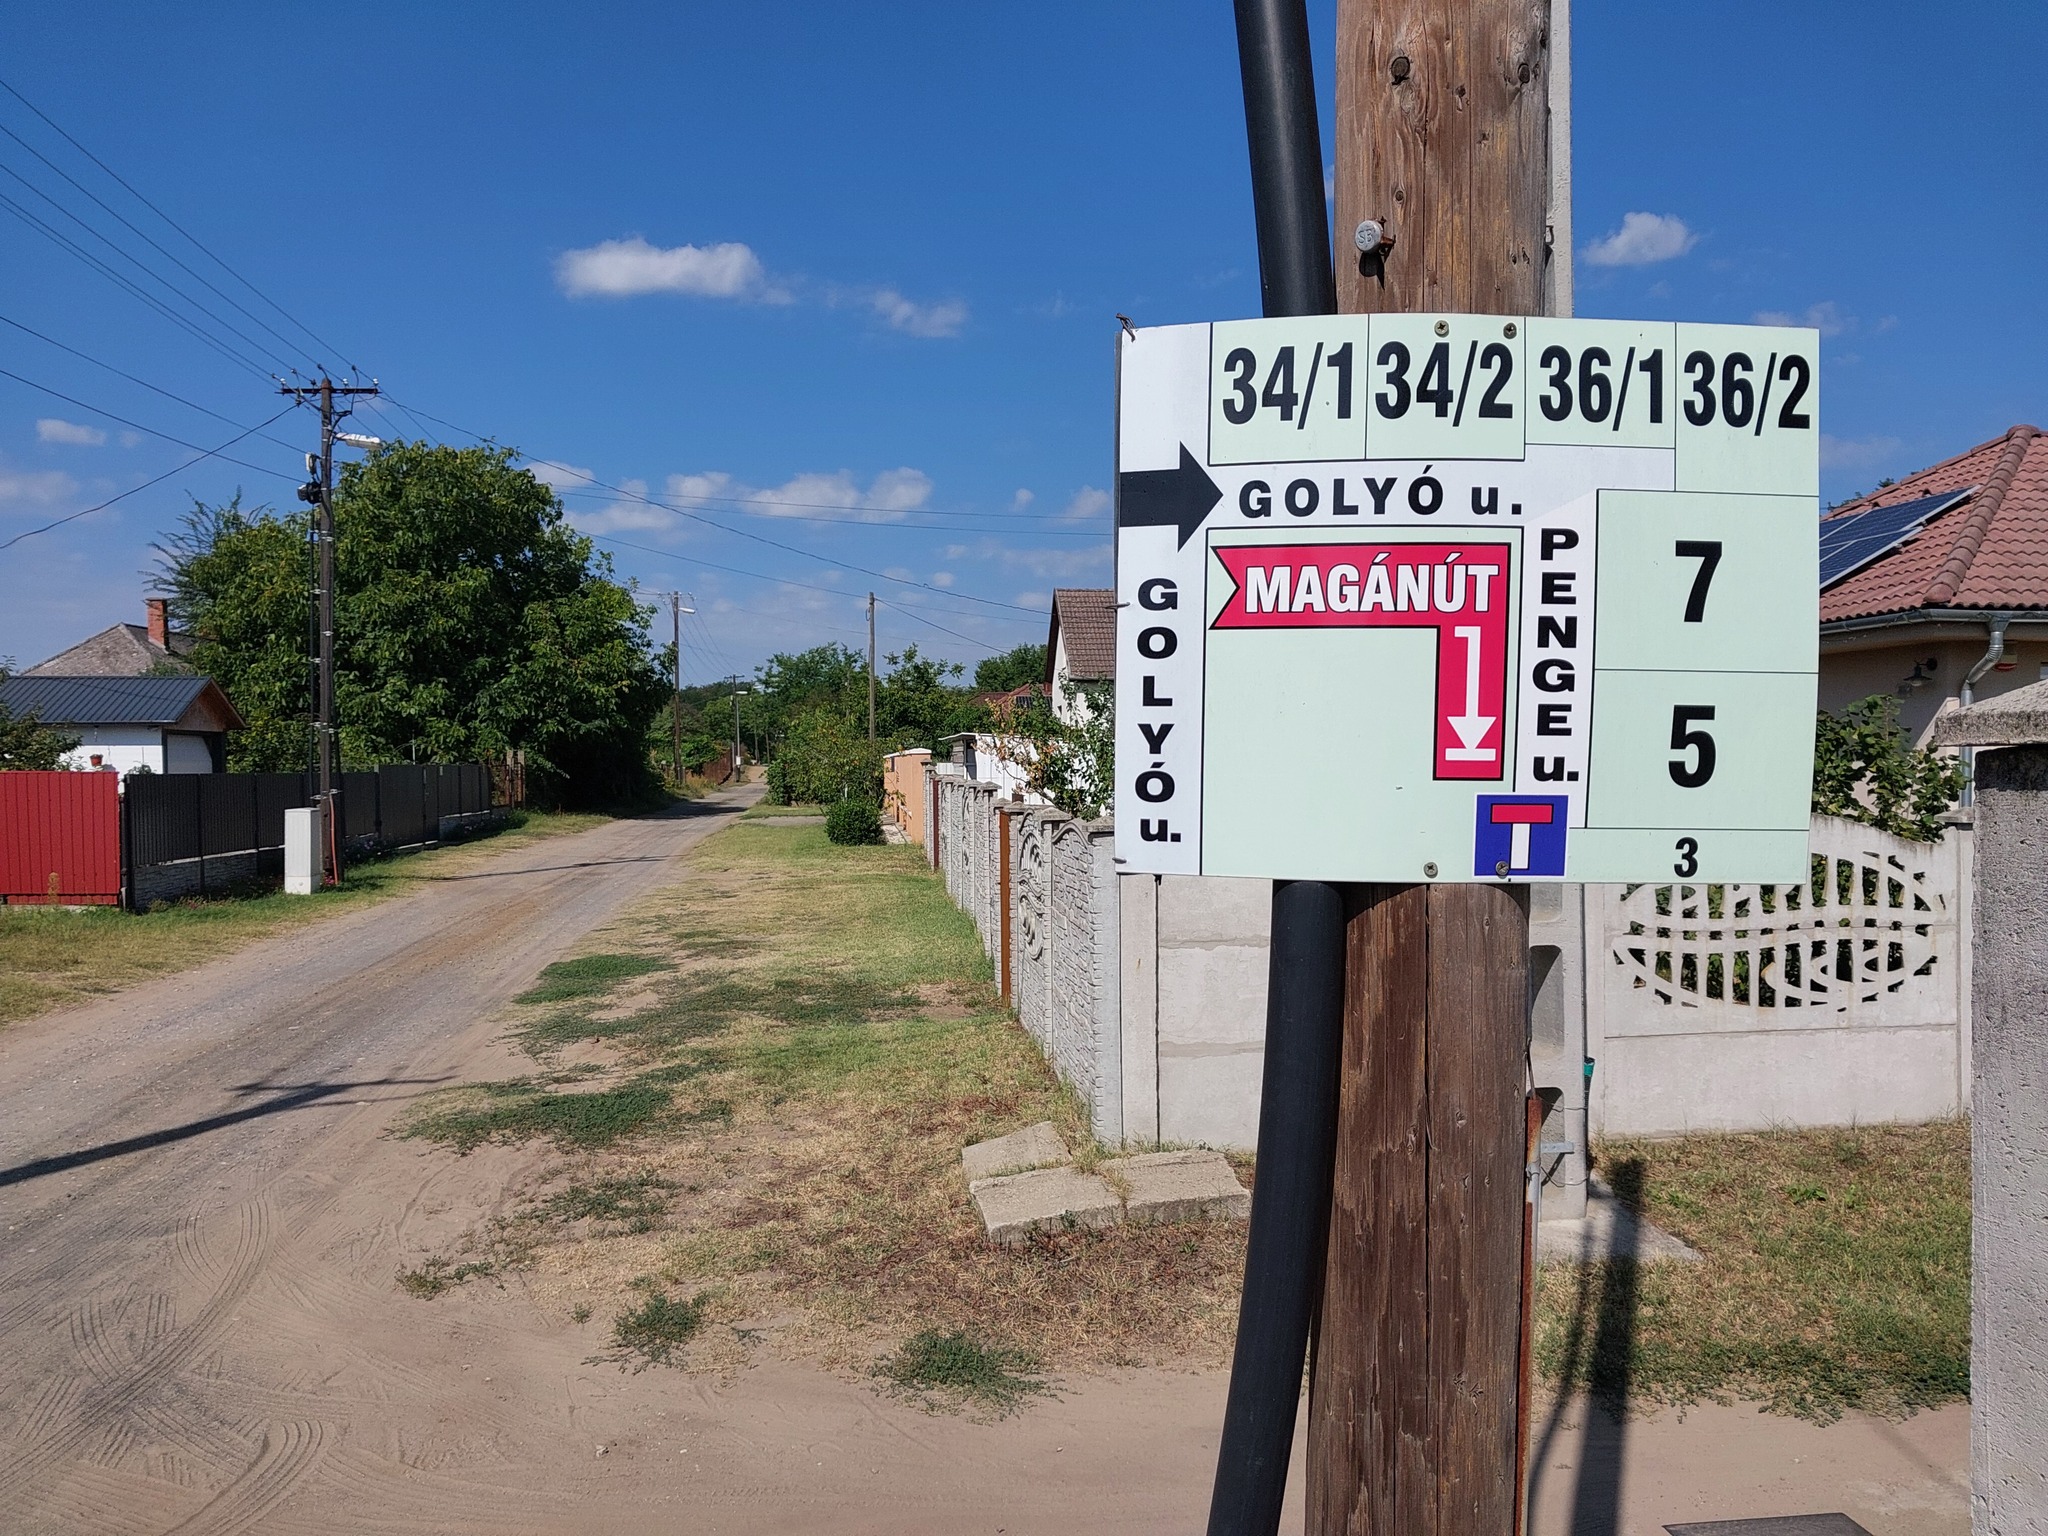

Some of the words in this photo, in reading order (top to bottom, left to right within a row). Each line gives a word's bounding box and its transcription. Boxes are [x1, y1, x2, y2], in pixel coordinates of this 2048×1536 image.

[1222, 342, 1354, 430] 34/1
[1375, 340, 1514, 427] 34/2
[1539, 346, 1664, 432] 36/1
[1683, 350, 1811, 437] 36/2
[1239, 464, 1445, 518] GOLYÓ
[1471, 486, 1523, 516] u.
[1245, 552, 1500, 613] MAGÁNÚT
[1675, 540, 1724, 623] 7
[1532, 528, 1580, 737] PENGE
[1134, 578, 1179, 803] GOLYÓ
[1532, 756, 1580, 782] u.
[1668, 704, 1717, 789] 5
[1140, 818, 1182, 843] u.
[1673, 837, 1700, 878] 3
